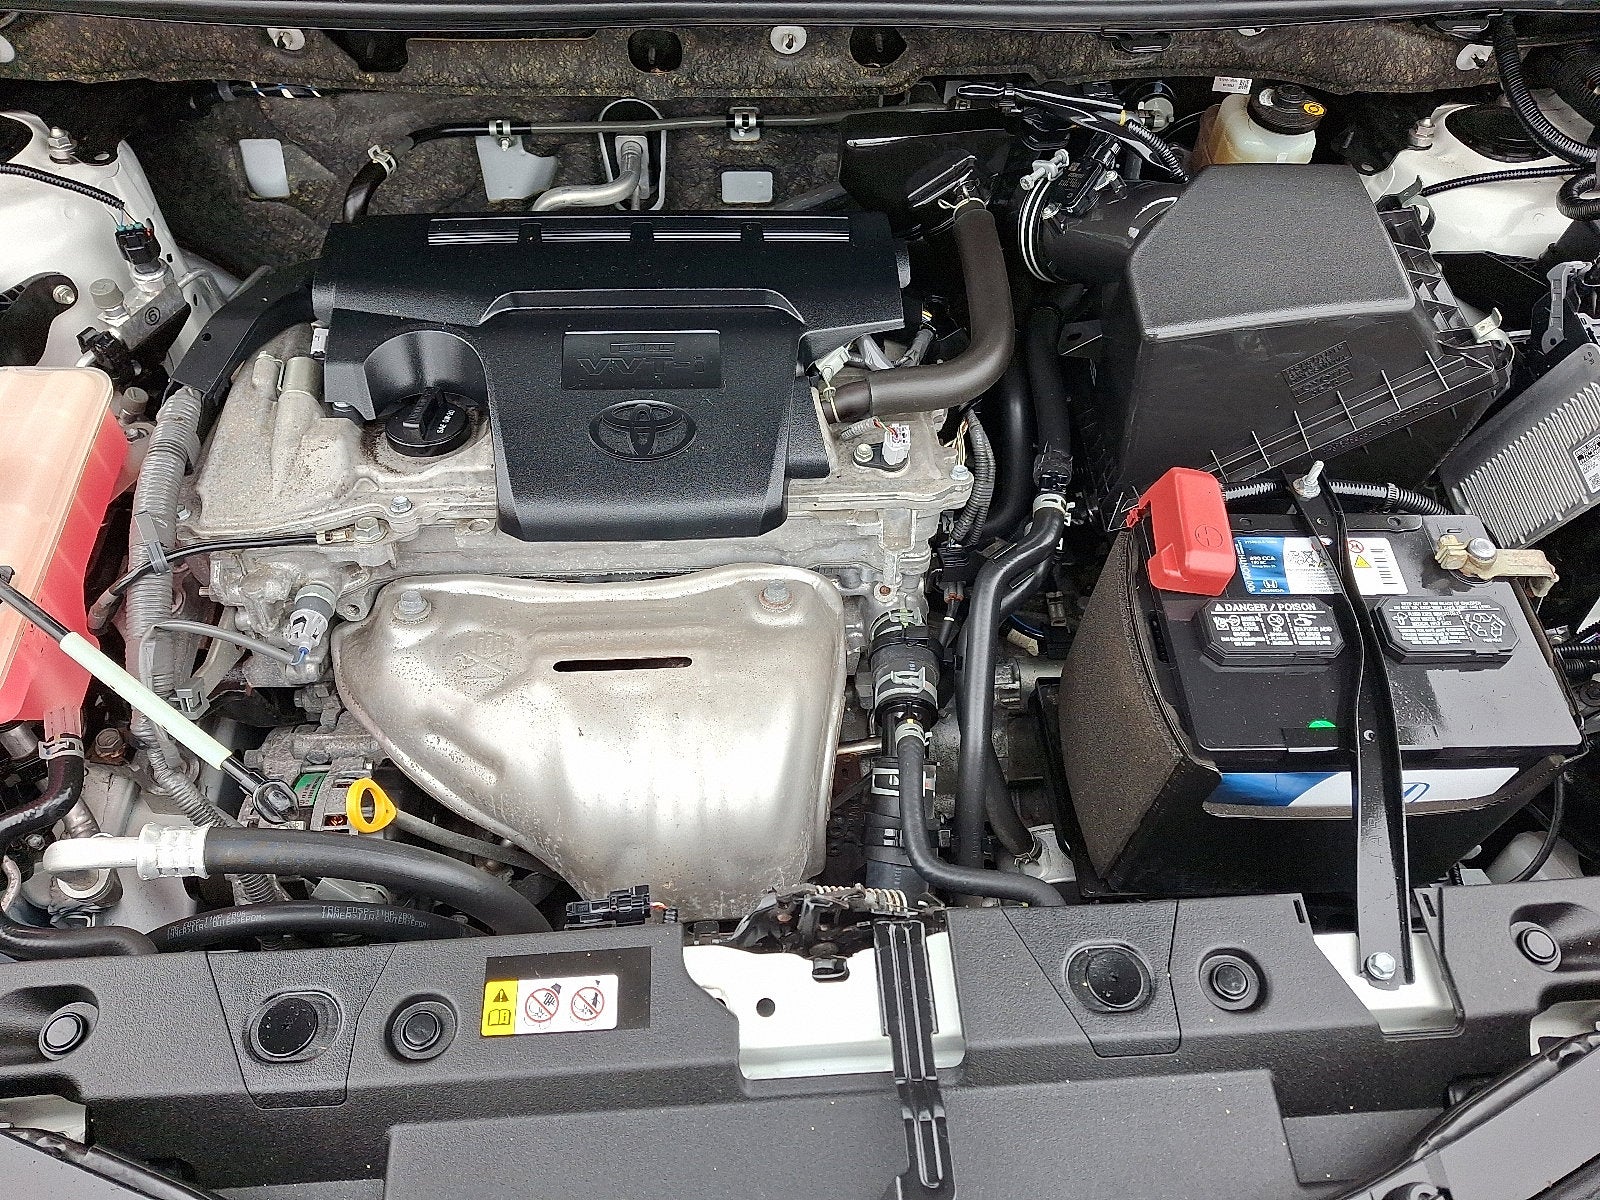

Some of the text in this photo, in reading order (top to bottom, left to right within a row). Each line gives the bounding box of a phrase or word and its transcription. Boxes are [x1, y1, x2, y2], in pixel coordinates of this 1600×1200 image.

[577, 356, 704, 375] VVT-i
[1224, 603, 1268, 612] DANGER
[1278, 602, 1317, 611] POISON
